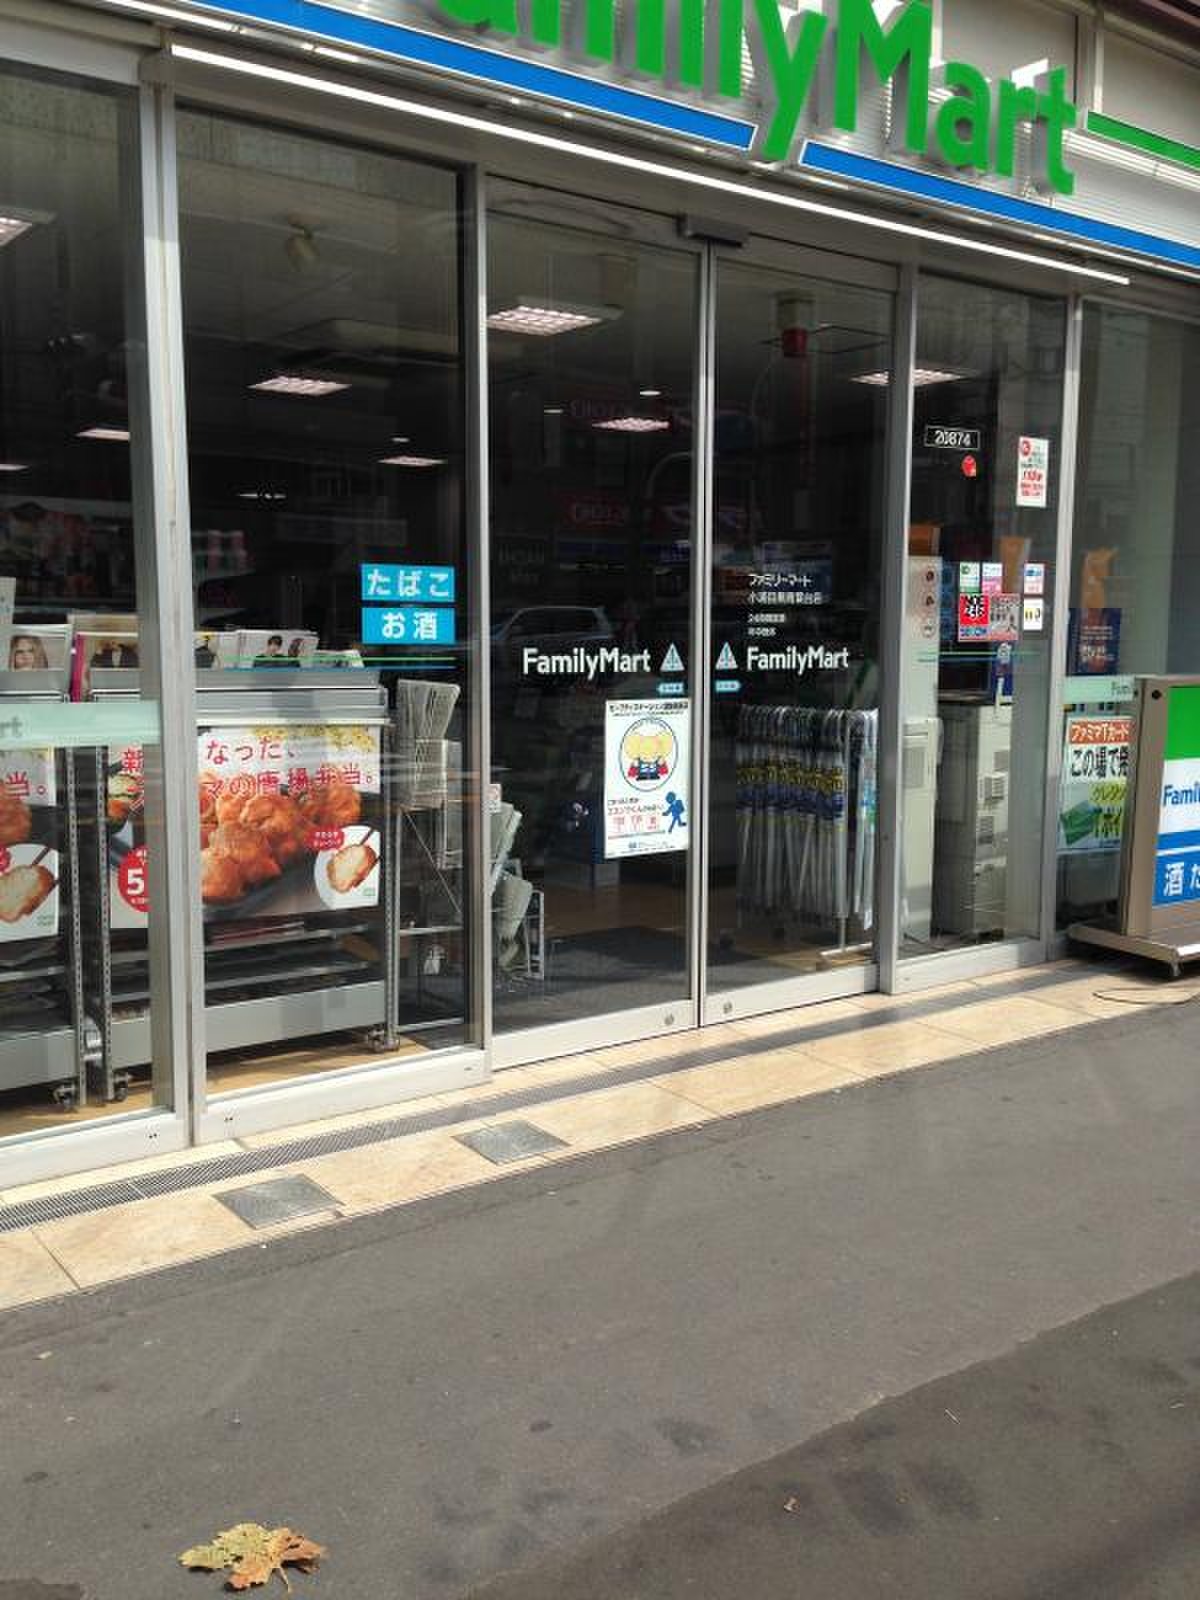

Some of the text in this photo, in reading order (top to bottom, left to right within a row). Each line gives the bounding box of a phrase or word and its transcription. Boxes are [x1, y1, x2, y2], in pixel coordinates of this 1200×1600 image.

[367, 568, 449, 597] たばこ
[748, 573, 813, 588] ファミリーマート
[382, 611, 438, 640] お酒
[523, 646, 651, 680] FamilyMart
[747, 645, 849, 675] FamilyMart
